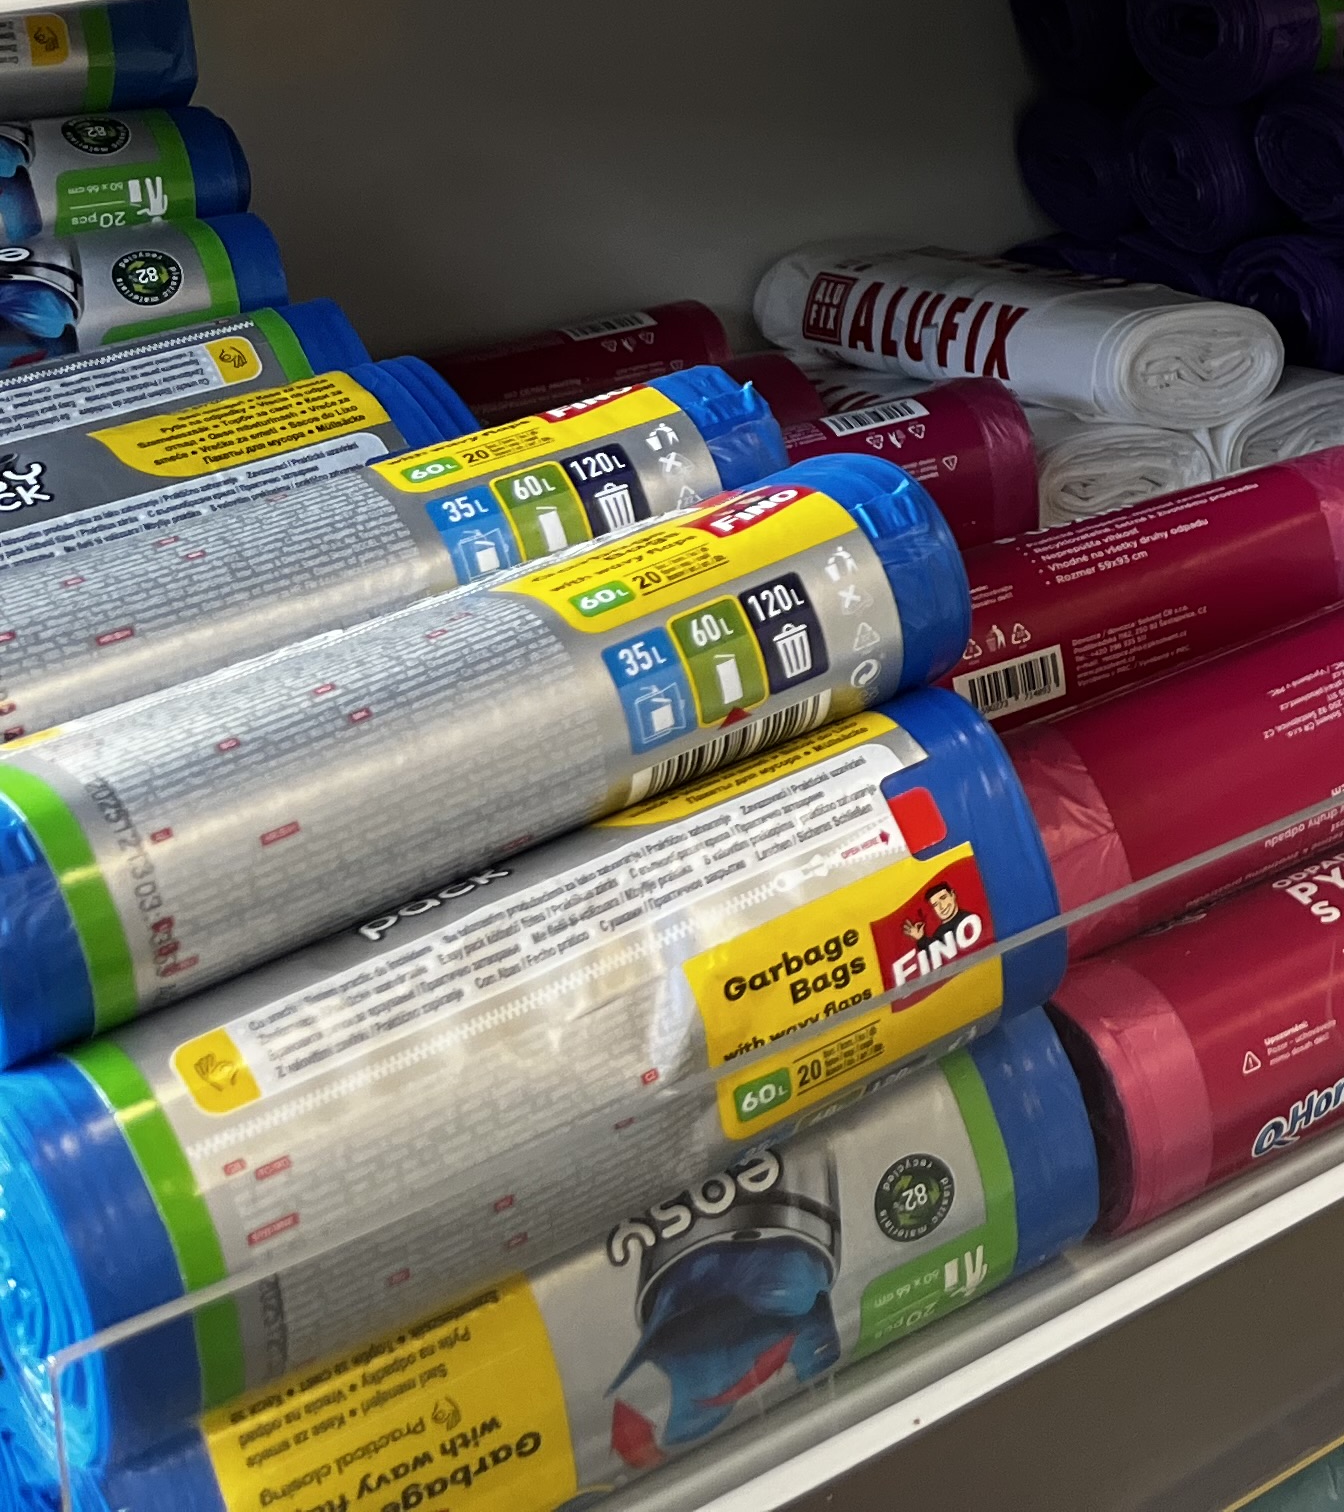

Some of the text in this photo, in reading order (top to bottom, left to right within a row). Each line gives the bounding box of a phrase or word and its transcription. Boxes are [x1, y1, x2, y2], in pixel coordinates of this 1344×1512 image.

[849, 282, 1029, 380] ALUFIX
[710, 487, 798, 534] FINO
[1310, 896, 1341, 924] S
[723, 928, 860, 1001] Garbage
[790, 956, 867, 1004] Bags
[797, 1060, 823, 1087] 20
